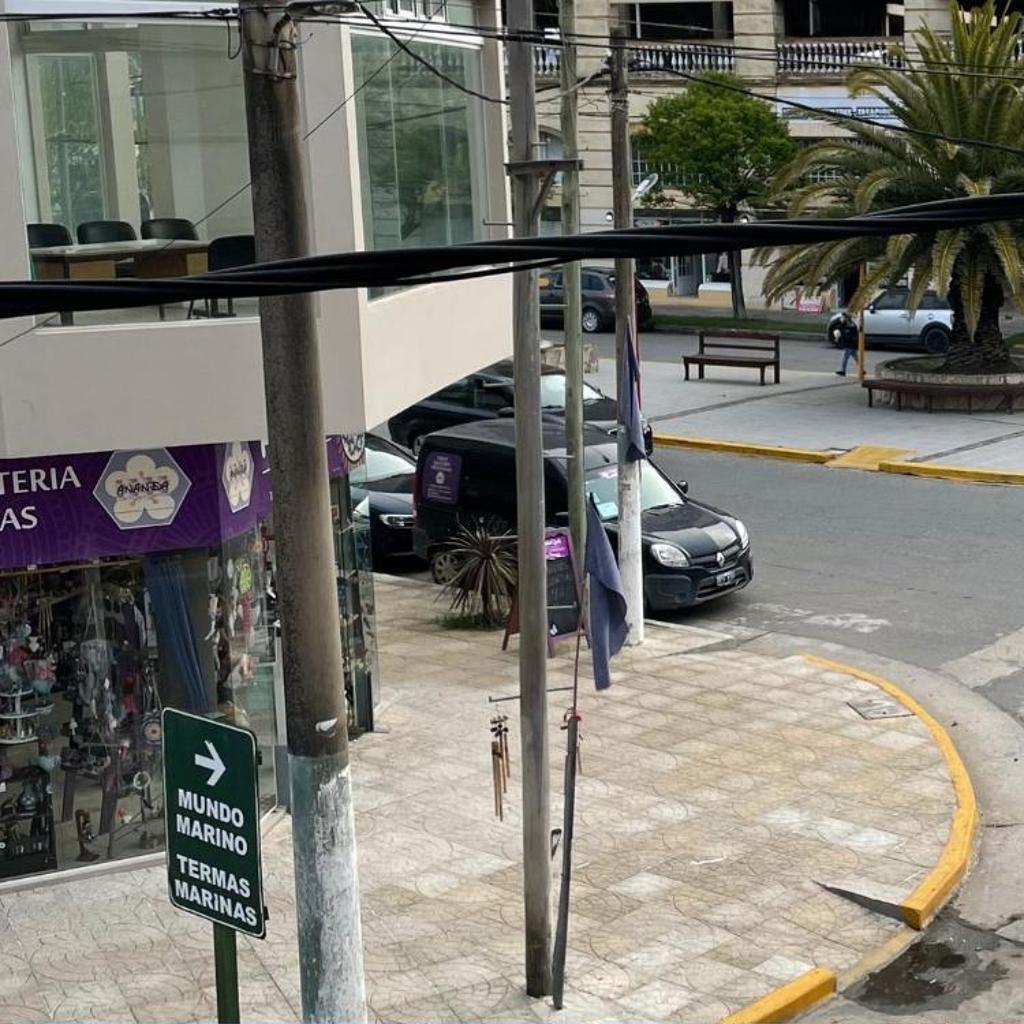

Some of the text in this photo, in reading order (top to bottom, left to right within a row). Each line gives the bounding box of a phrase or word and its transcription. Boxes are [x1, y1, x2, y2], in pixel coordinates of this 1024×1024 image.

[0, 466, 82, 496] TERIA
[0, 505, 39, 532] AS
[177, 788, 245, 828] MUNDO
[176, 814, 248, 856] MARINO
[176, 853, 251, 899] TERMAS
[174, 879, 258, 927] MARINAS
